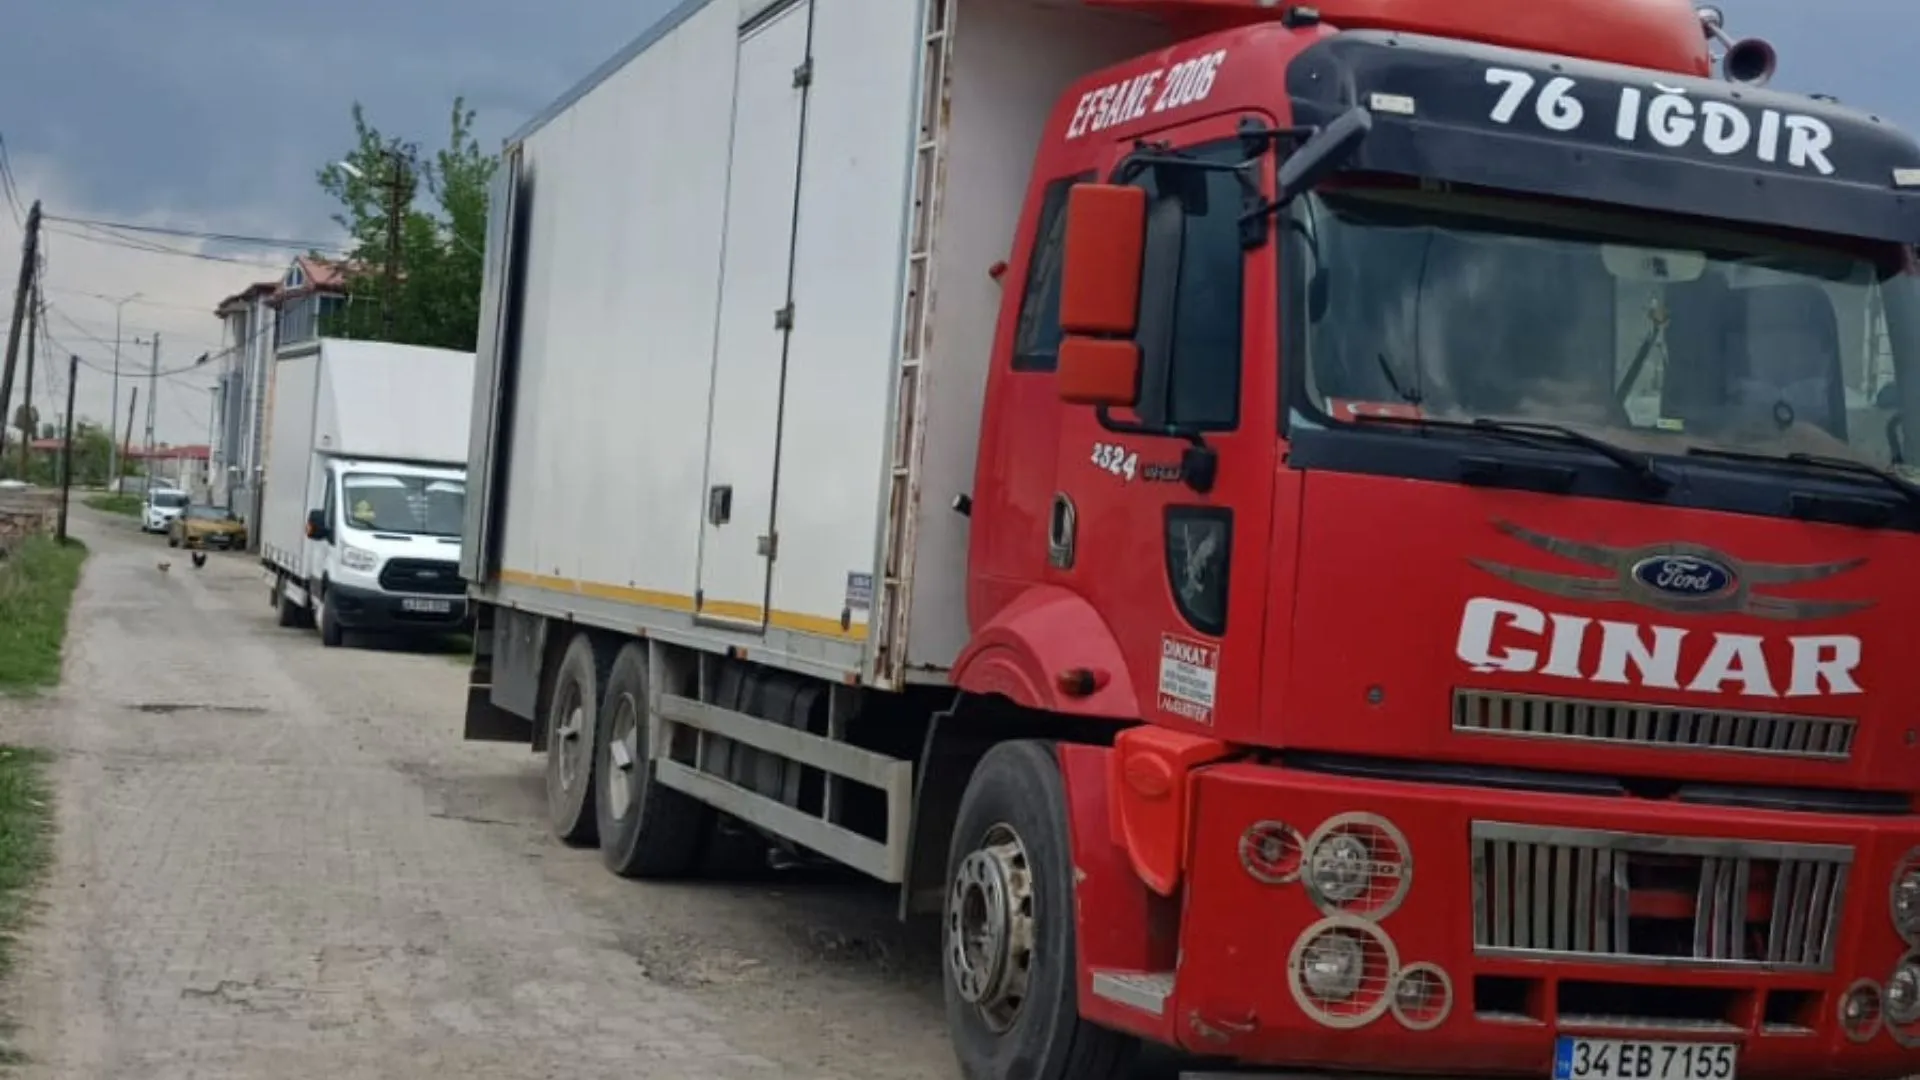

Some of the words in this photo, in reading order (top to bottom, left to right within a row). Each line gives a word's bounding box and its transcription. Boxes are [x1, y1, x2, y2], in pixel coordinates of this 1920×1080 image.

[1065, 69, 1164, 139] EFSANE
[1152, 48, 1227, 113] 2006
[1485, 68, 1584, 131] 76
[1615, 81, 1835, 175] IĞDIR
[1091, 442, 1138, 481] 2524
[1657, 560, 1712, 591] Ford
[1456, 597, 1864, 698] ÇINAR
[1574, 1042, 1610, 1078] 34
[1617, 1044, 1654, 1078] EB
[1661, 1046, 1733, 1079] 7155
